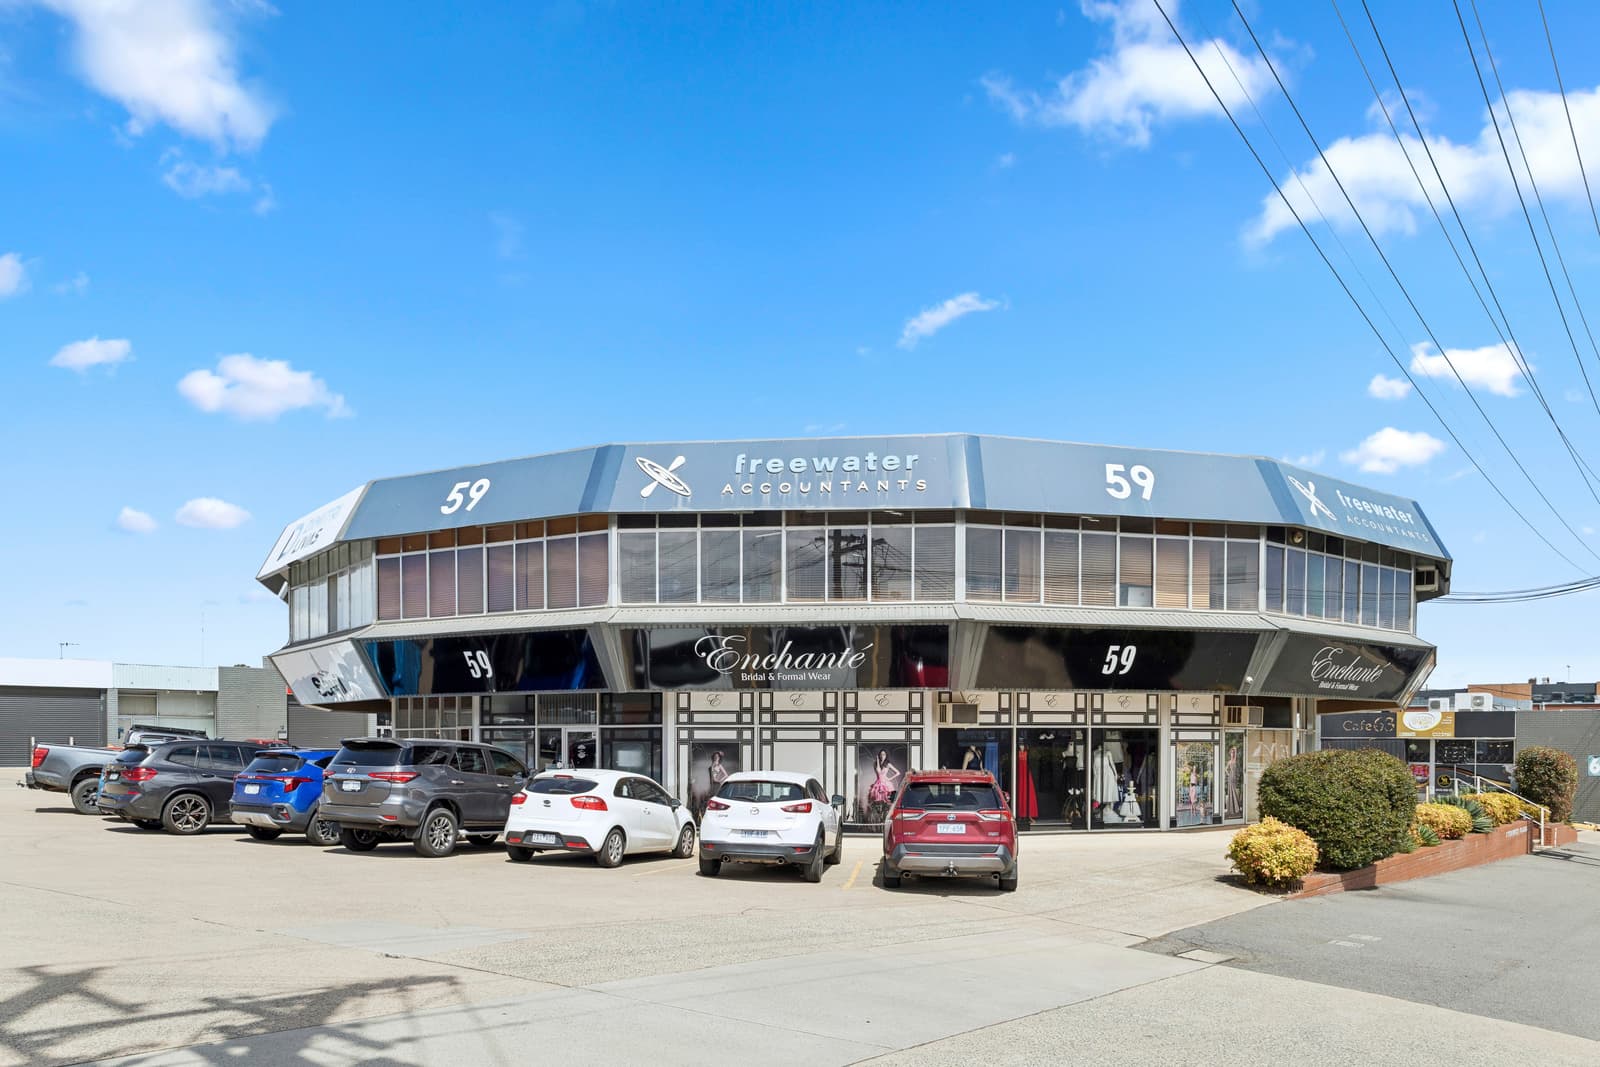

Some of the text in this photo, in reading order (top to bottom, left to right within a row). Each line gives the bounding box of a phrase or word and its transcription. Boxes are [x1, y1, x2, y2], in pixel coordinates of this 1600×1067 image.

[734, 451, 919, 475] freewater
[440, 478, 490, 515] 59
[721, 479, 927, 495] ACCOUNTANTS
[1105, 463, 1155, 501] 59
[1335, 489, 1415, 525] freewater
[1346, 515, 1429, 543] ACCOUNTANTS
[463, 650, 493, 678] 59
[694, 634, 874, 675] Enchanté
[1102, 645, 1137, 675] 59
[1310, 646, 1392, 682] Enchanté
[741, 671, 831, 681] Bridal & Formal Wear
